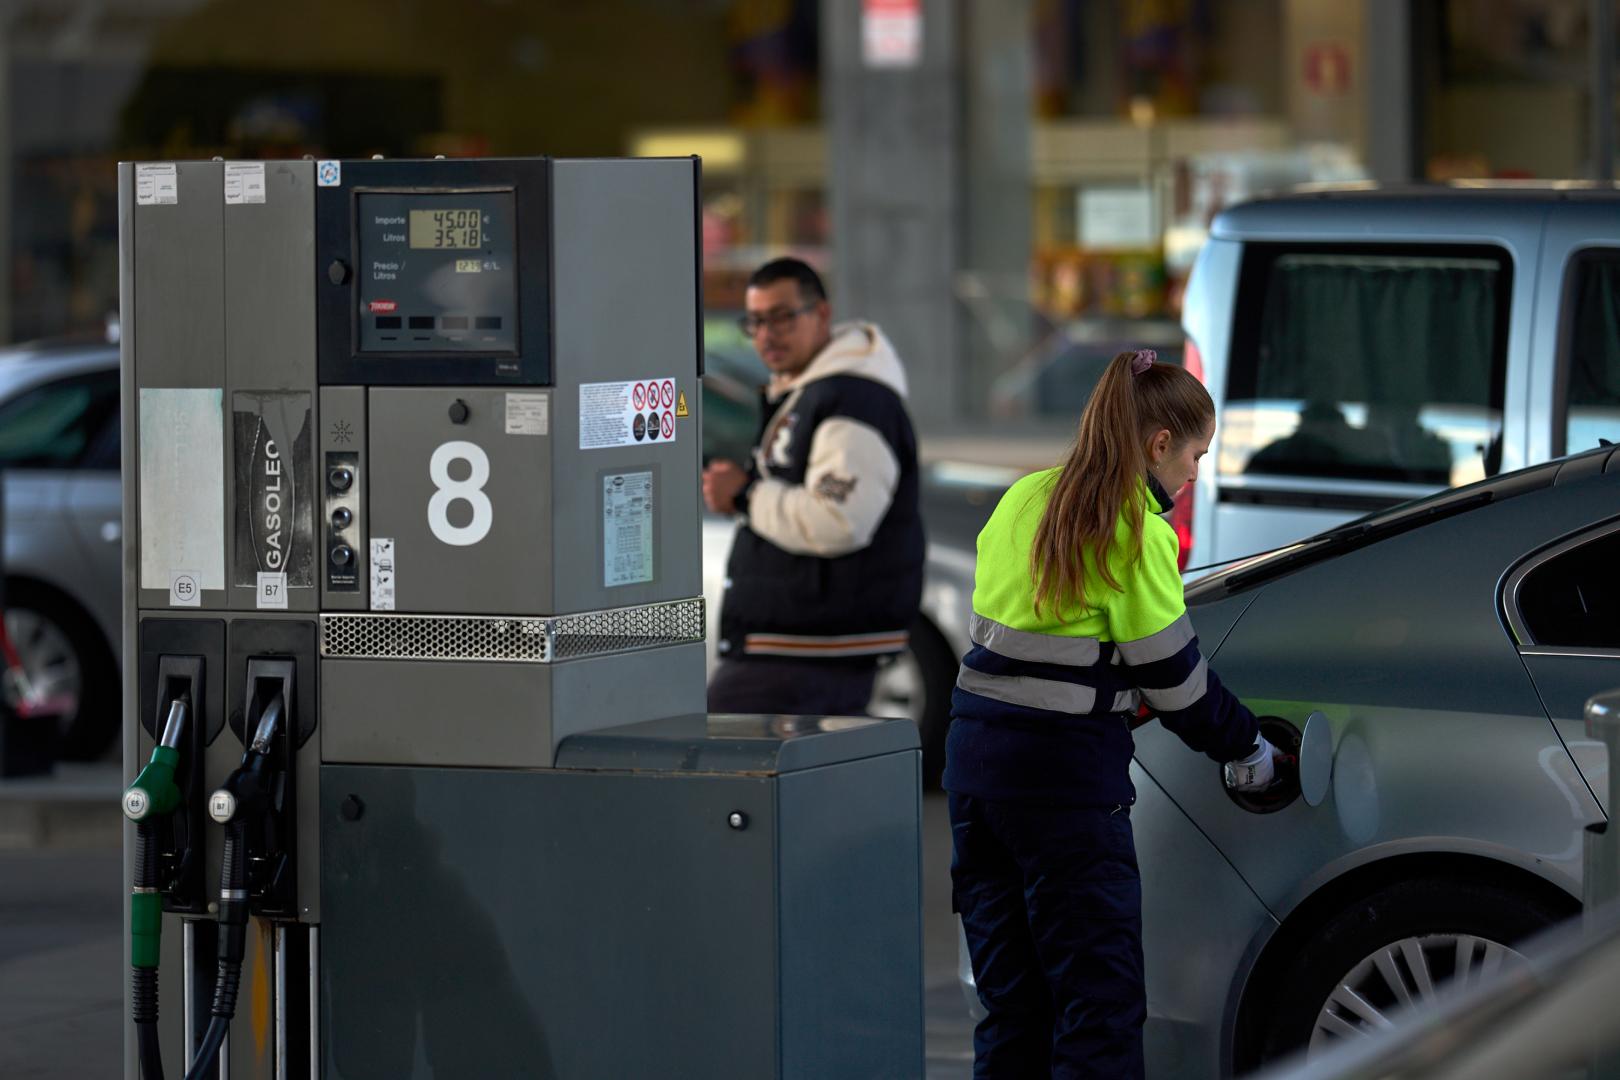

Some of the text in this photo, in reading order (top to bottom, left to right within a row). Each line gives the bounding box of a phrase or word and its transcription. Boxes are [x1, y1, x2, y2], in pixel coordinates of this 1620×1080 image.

[375, 216, 406, 225] Importe
[383, 233, 406, 242] Litros
[373, 262, 399, 271] Precio
[373, 271, 396, 280] Litros
[428, 440, 493, 546] 8
[178, 583, 192, 593] E5
[265, 585, 278, 595] B7
